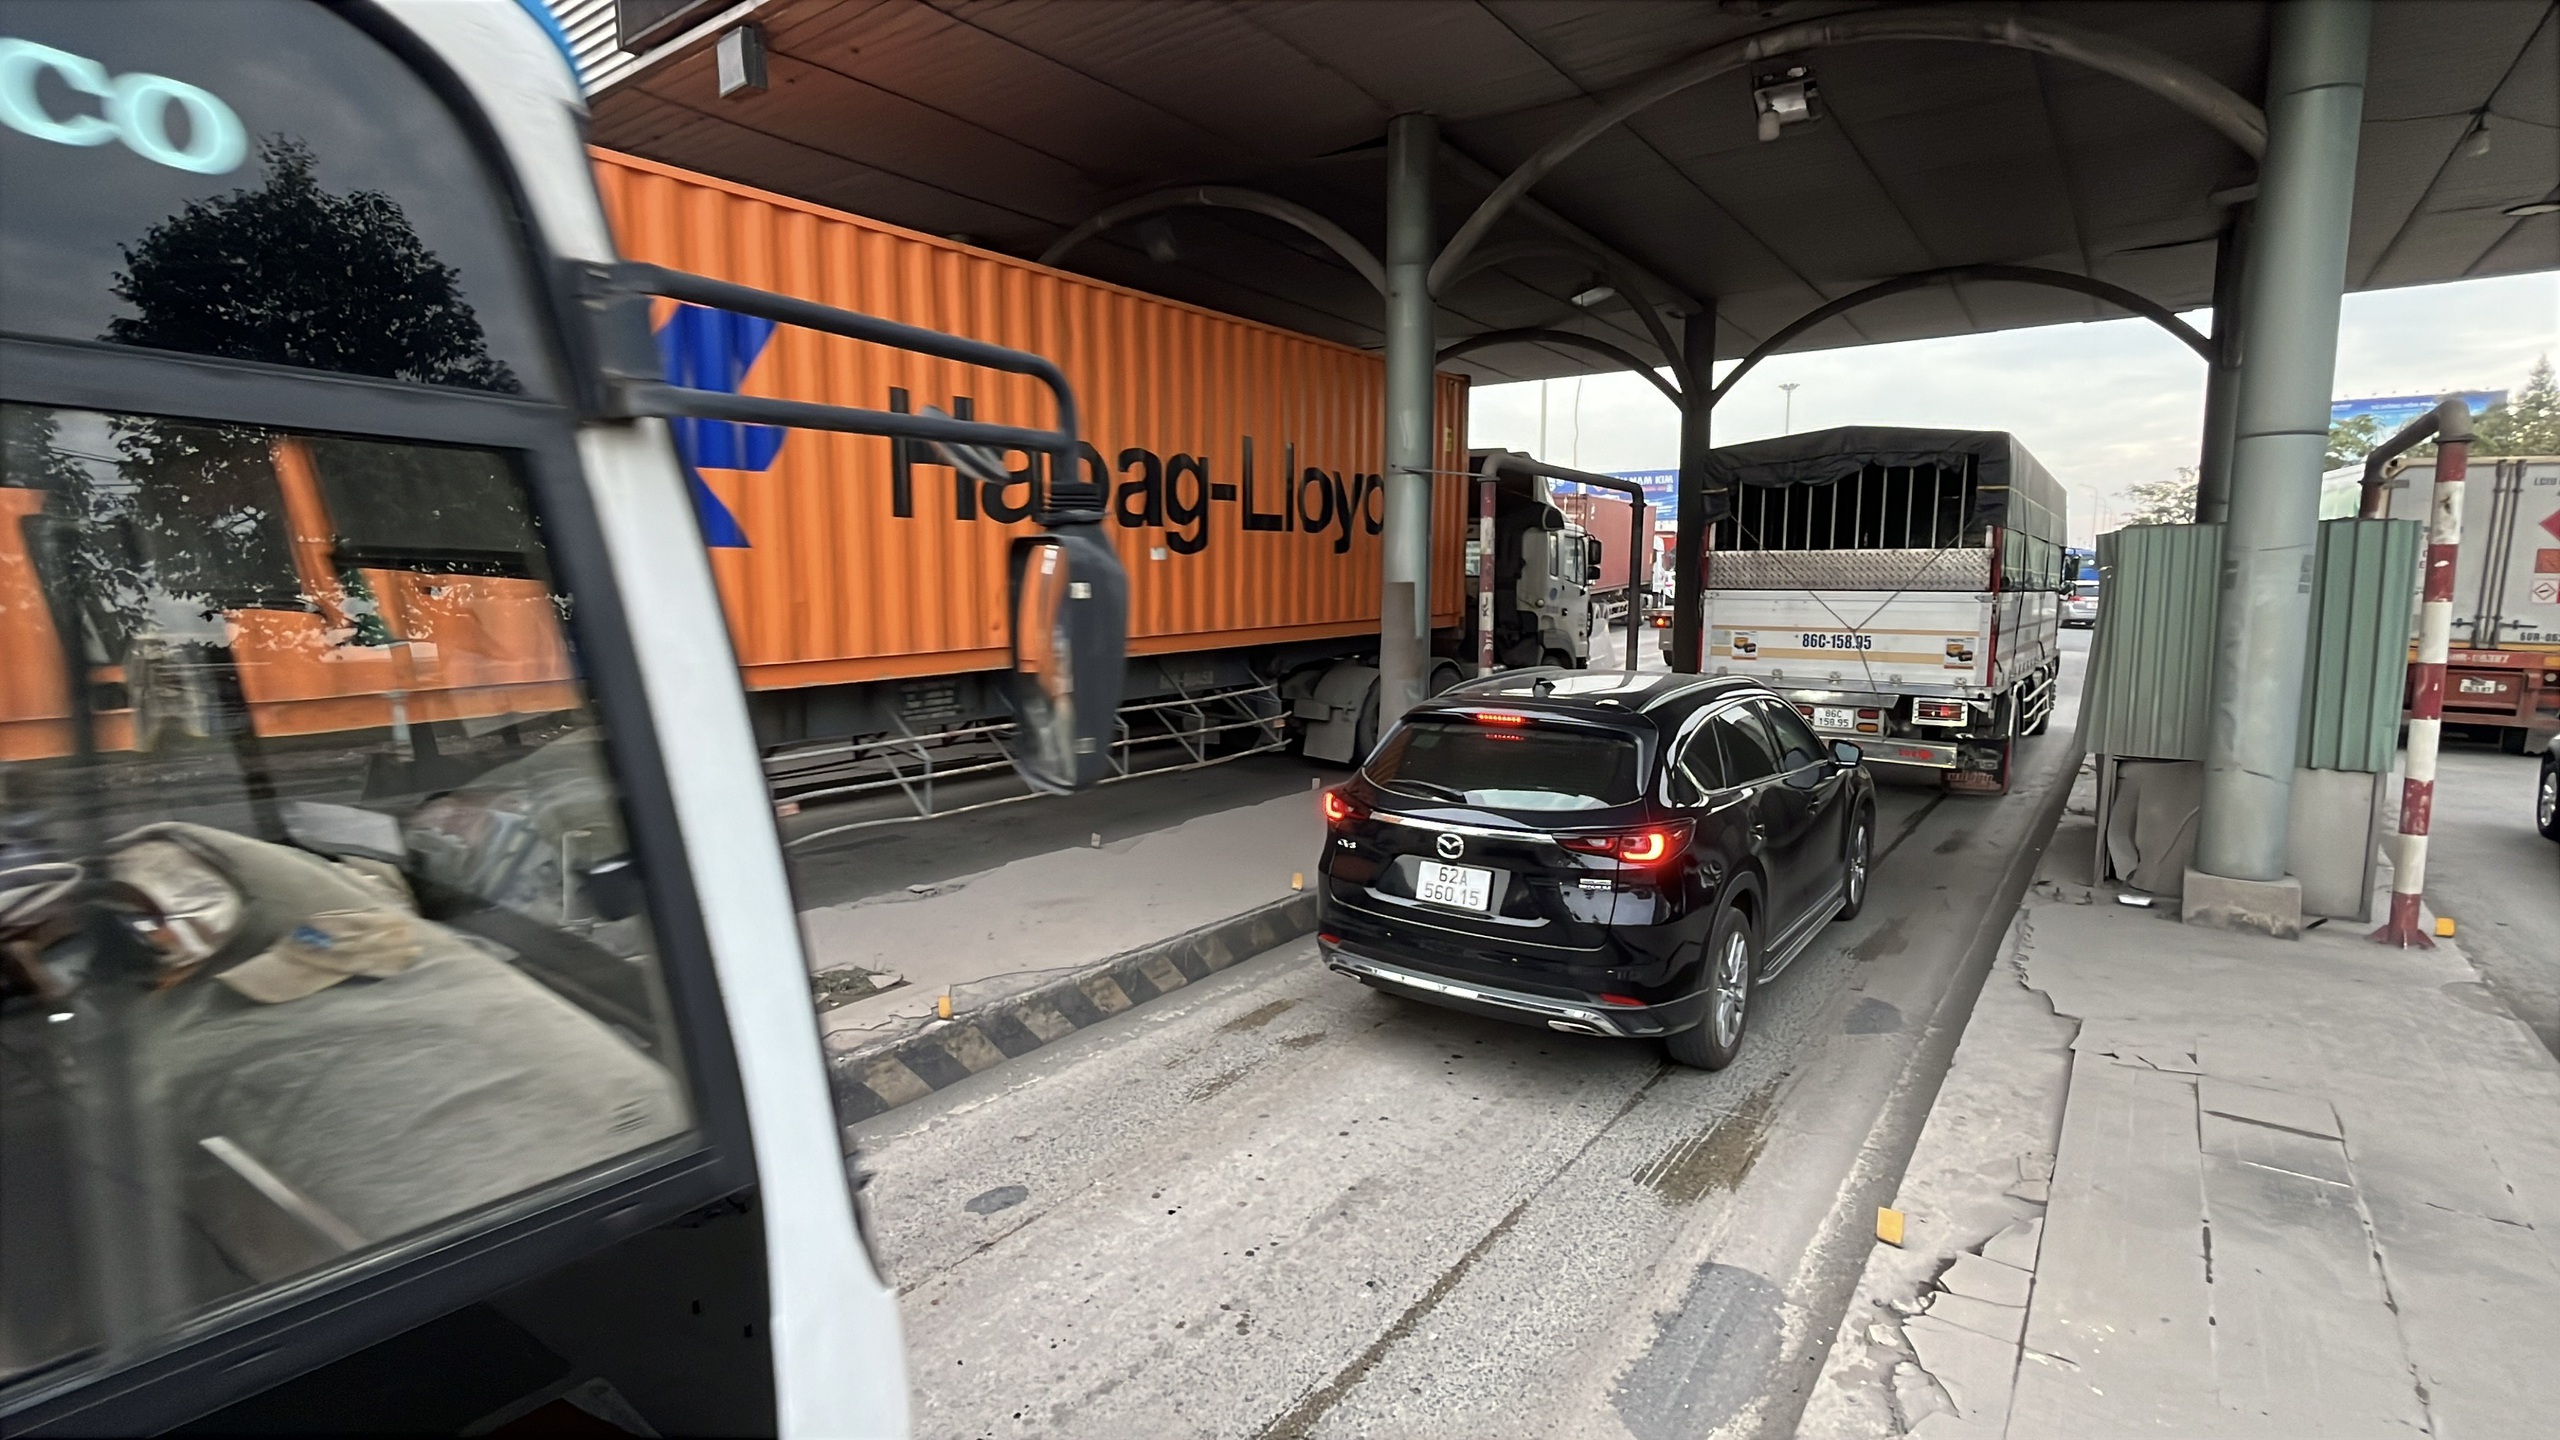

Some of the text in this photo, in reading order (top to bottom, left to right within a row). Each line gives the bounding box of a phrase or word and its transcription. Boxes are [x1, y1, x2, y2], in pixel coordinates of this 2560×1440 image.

[1655, 475, 1674, 484] KIM
[1802, 633, 1871, 650] 86C-158.95
[1825, 709, 1842, 718] 86C
[1439, 866, 1468, 887] 62A
[1424, 882, 1479, 907] 560.15
